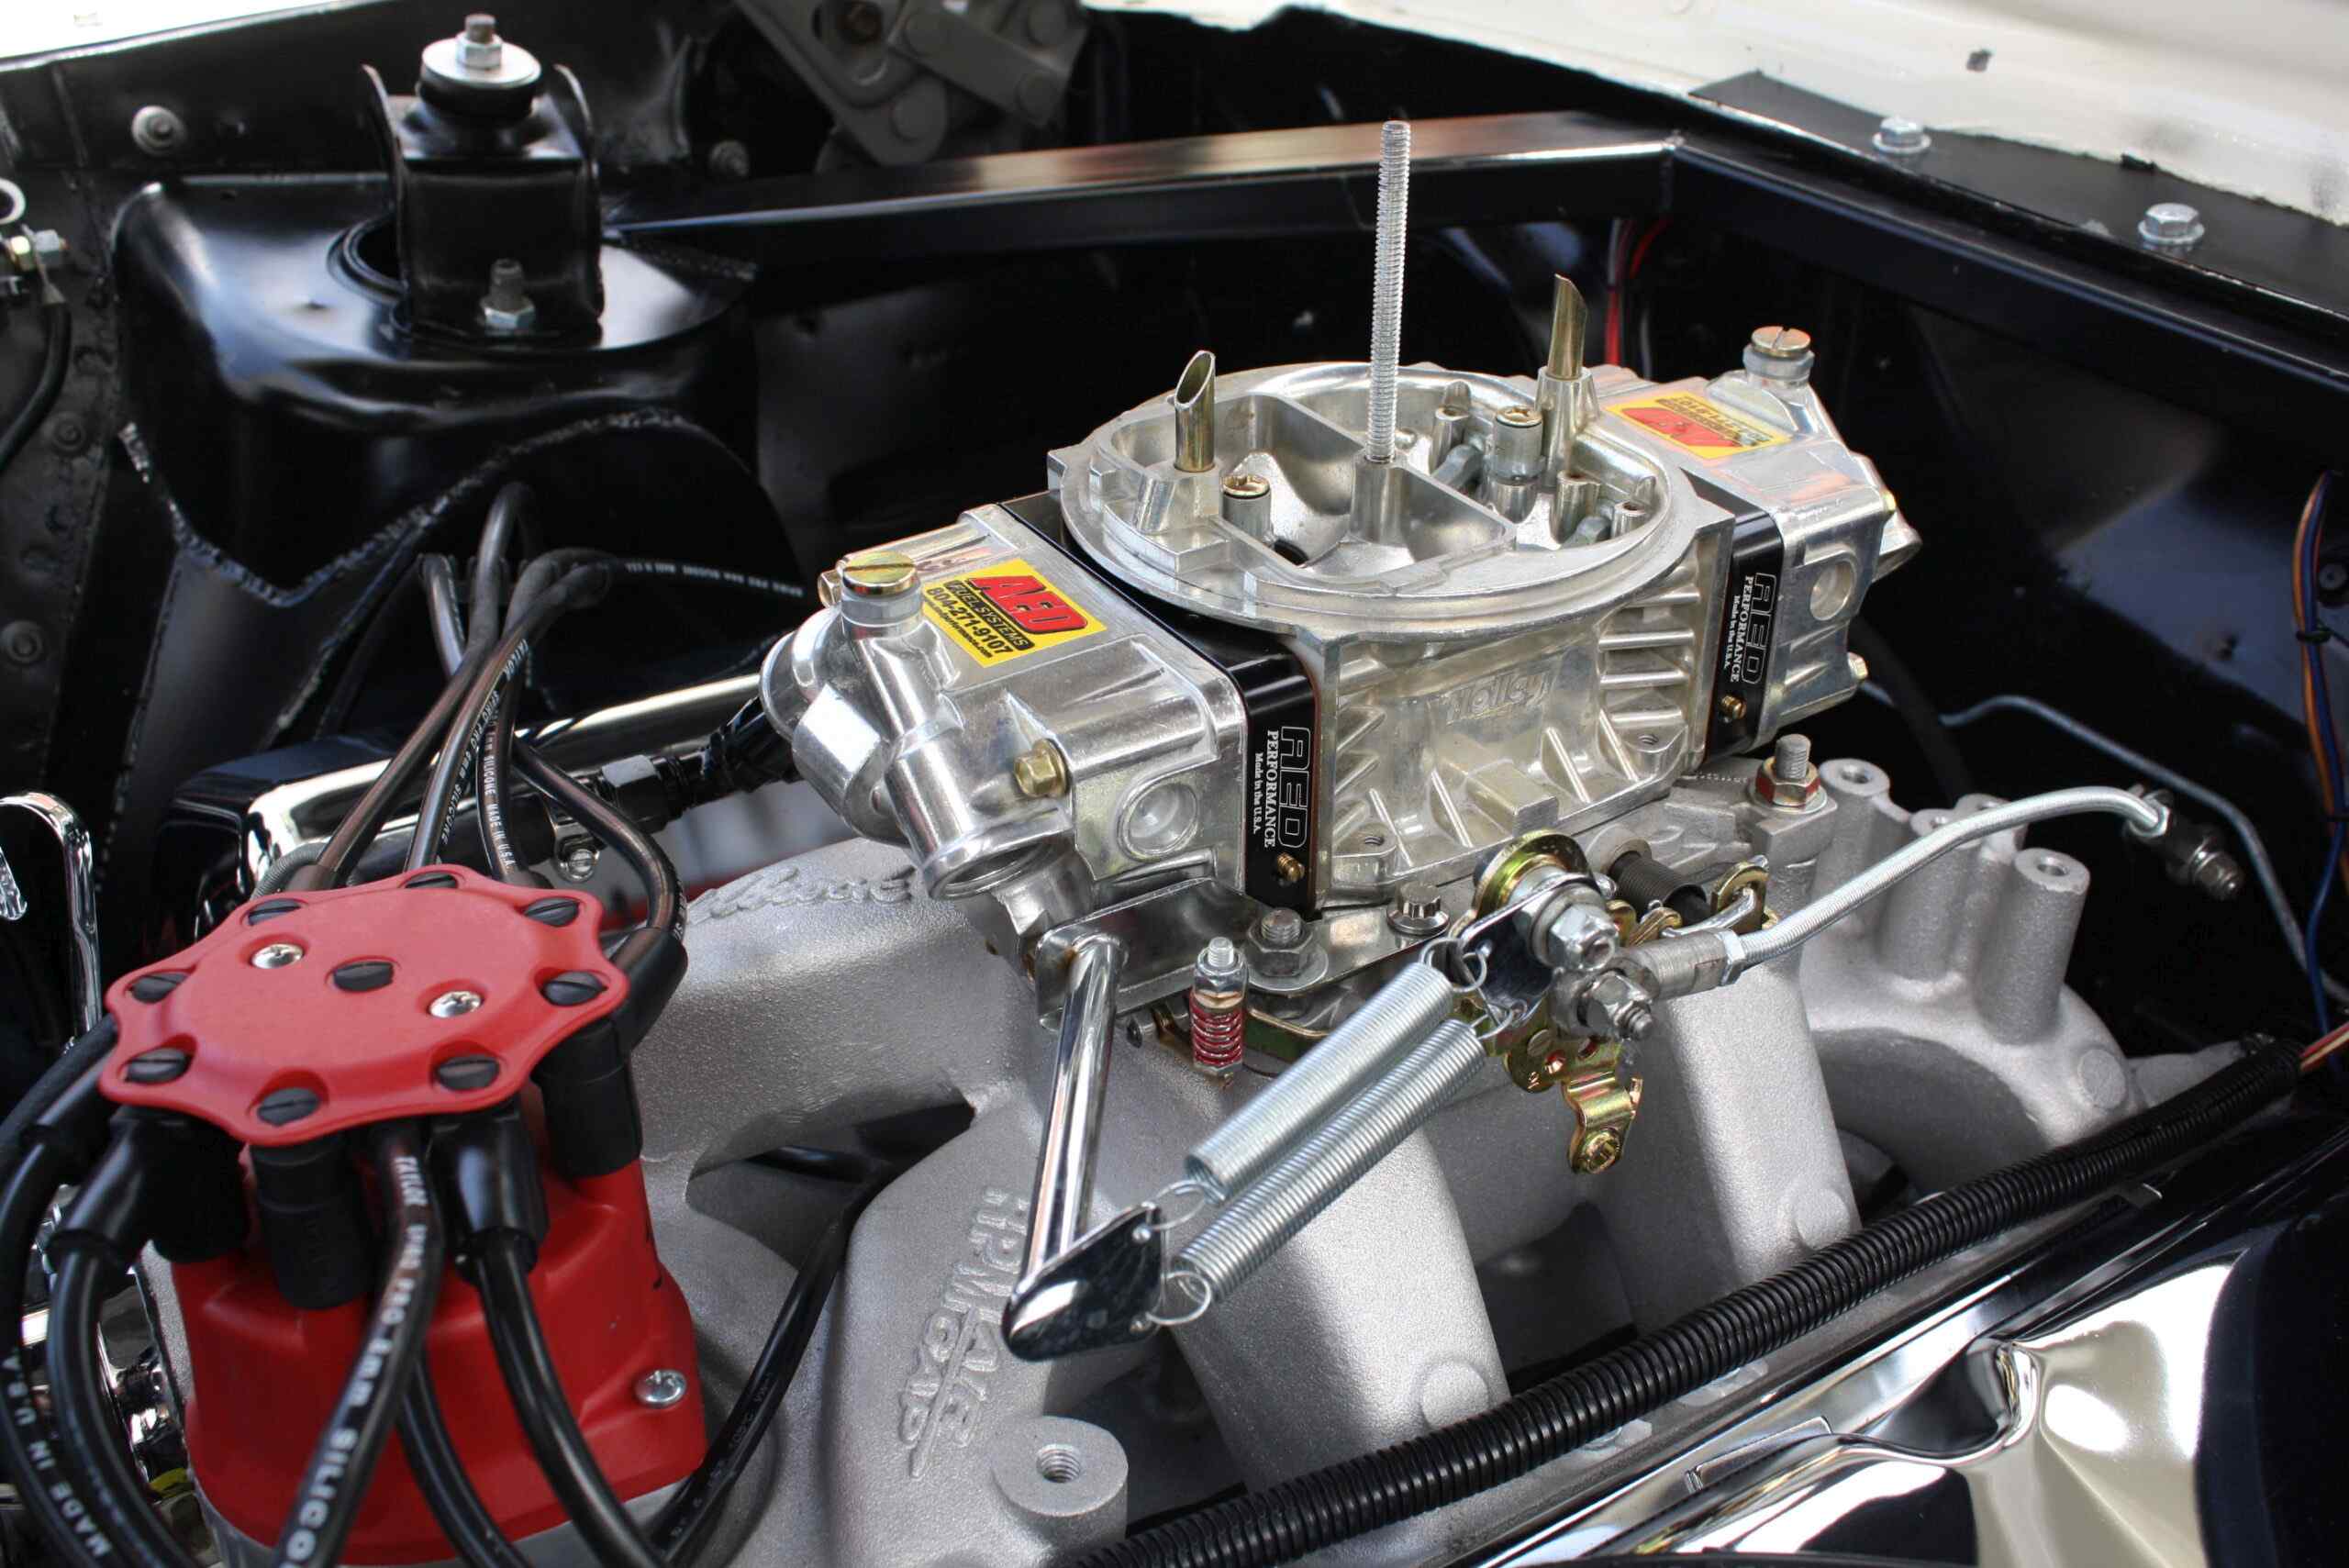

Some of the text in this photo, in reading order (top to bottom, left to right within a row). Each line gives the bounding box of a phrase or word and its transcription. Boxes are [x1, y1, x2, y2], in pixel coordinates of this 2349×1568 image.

[947, 580, 1029, 648] FUEL SYSTEMS
[965, 574, 1088, 635] AED
[1731, 575, 1754, 683] PERFORMANCE
[1742, 573, 1776, 684] AED
[484, 754, 497, 795] SILICONE
[1254, 752, 1264, 779] Made
[1254, 780, 1264, 789] in
[1264, 729, 1279, 848] PERFORMANCE
[1277, 726, 1311, 849] AED
[441, 784, 462, 845] SILICONE
[486, 803, 502, 828] MADE
[1253, 789, 1264, 806] the
[492, 830, 507, 840] IN
[27, 1440, 57, 1470] IN
[49, 1481, 113, 1557] MADE
[278, 1428, 359, 1568] SILICO
